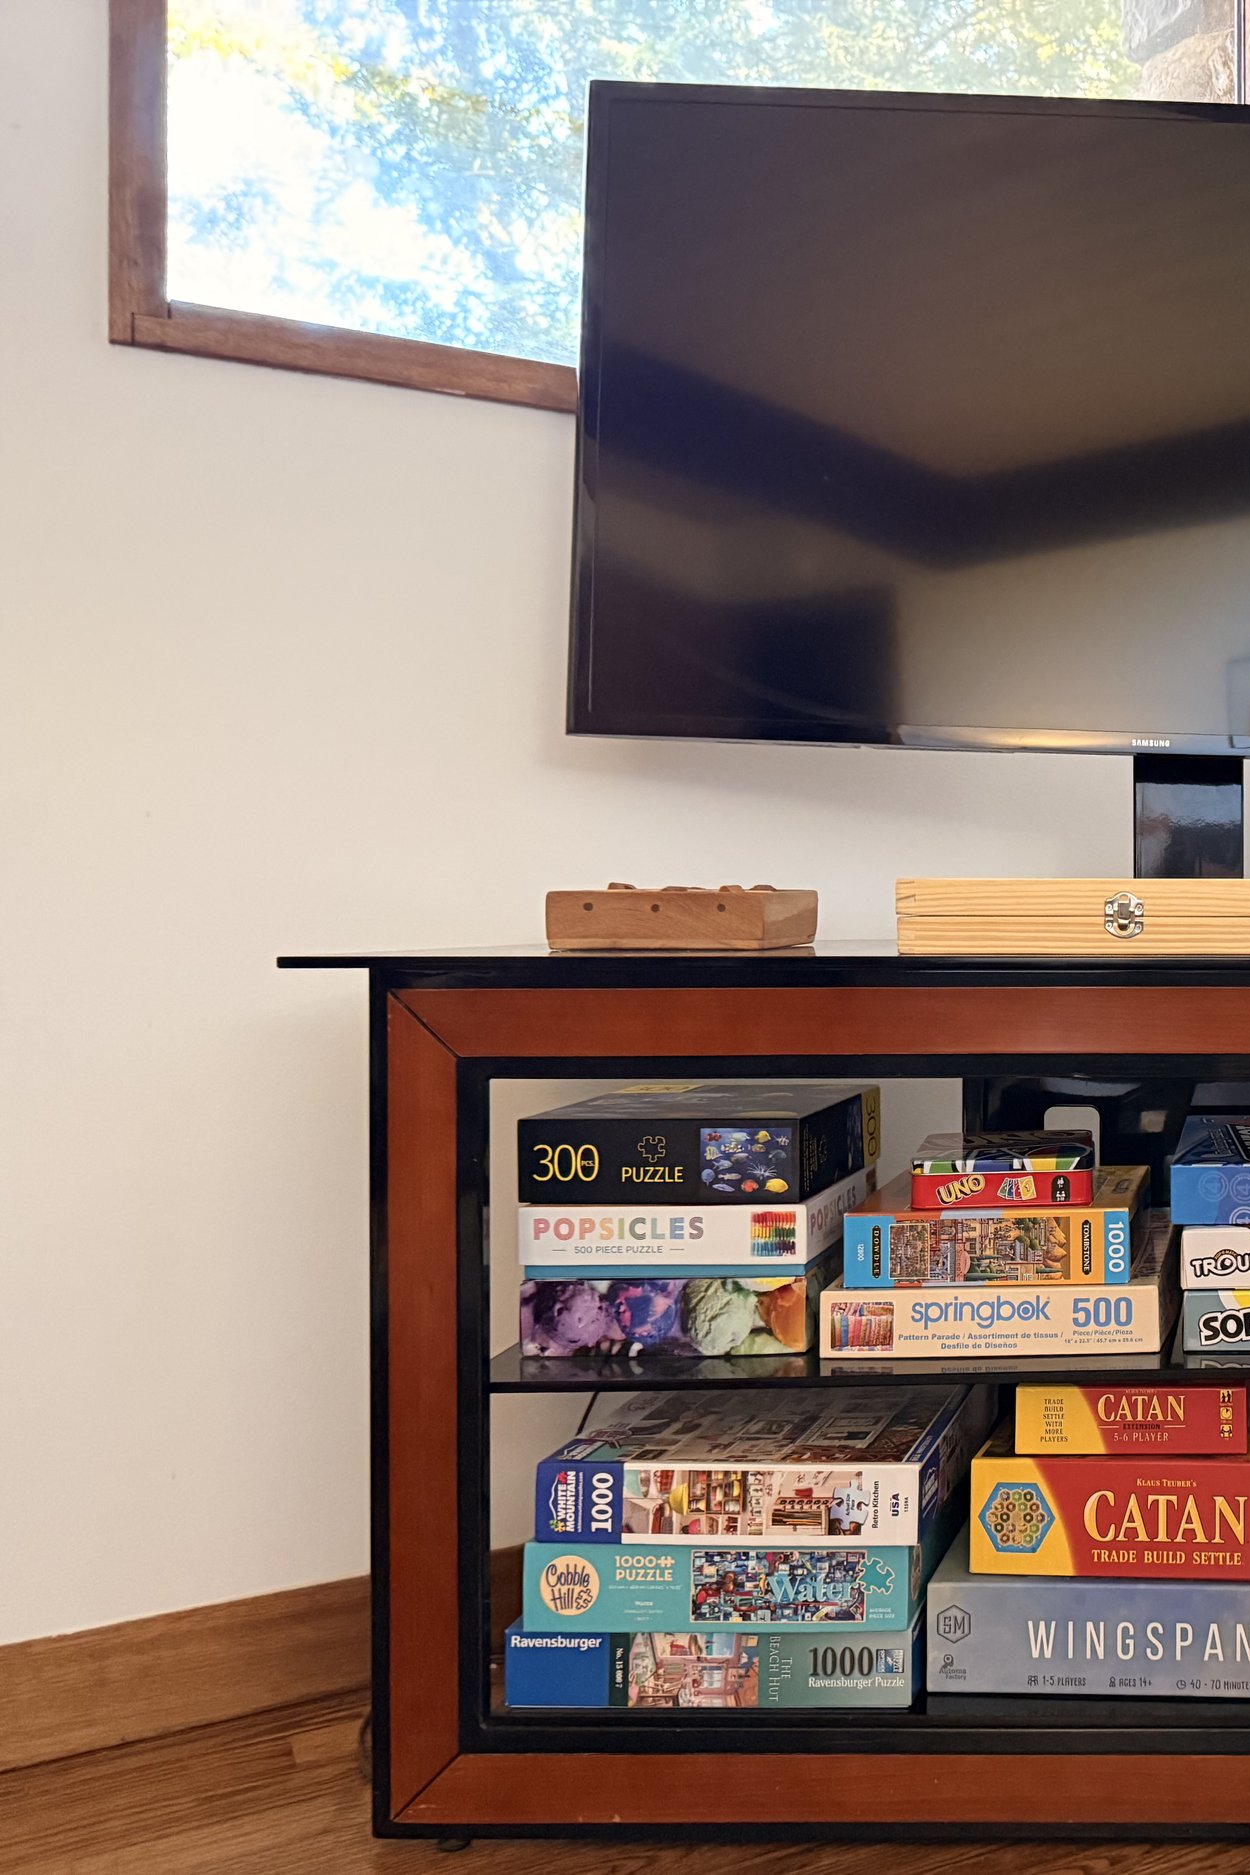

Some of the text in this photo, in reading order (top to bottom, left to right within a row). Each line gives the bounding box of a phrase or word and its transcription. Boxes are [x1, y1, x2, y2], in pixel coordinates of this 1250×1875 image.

[1131, 738, 1170, 747] SAMSUNG
[865, 1098, 878, 1157] 300
[532, 1144, 599, 1182] 300
[621, 1166, 684, 1183] PUZZLE
[936, 1174, 986, 1205] UNO
[810, 1185, 857, 1236] POPSICLES
[532, 1216, 704, 1242] POPSICLES
[574, 1245, 663, 1254] 500 PIECE PUZZLE
[1108, 1221, 1125, 1272] 1000
[910, 1295, 1051, 1330] springbok
[1072, 1296, 1133, 1328] 500
[898, 1333, 929, 1341] Pattern
[931, 1333, 961, 1341] Parade
[967, 1332, 1019, 1340] Assortiment
[1034, 1331, 1059, 1339] tissus
[941, 1342, 969, 1350] Desfile
[984, 1341, 1018, 1349] Diseños
[1097, 1394, 1186, 1422] CATAN
[1113, 1432, 1169, 1442] 5-6 PLAYER
[1137, 1478, 1160, 1487] KLAUS
[557, 1471, 576, 1532] WHITE MOUNTAIN
[591, 1472, 614, 1533] 1000
[891, 1493, 900, 1517] USA
[1083, 1490, 1248, 1545] CATAN
[614, 1555, 657, 1568] 1000
[1092, 1550, 1242, 1566] TRADE BUILD SETTLE
[546, 1563, 590, 1588] Cobble
[615, 1569, 673, 1581] PUZZLE
[768, 1572, 859, 1602] Water
[551, 1588, 575, 1612] Hill
[943, 1616, 965, 1634] SM
[511, 1635, 602, 1651] Ravensburger
[768, 1636, 781, 1701] BEACH HUT
[780, 1657, 793, 1679] THE
[808, 1646, 873, 1677] 1000
[939, 1667, 967, 1675] Automa
[808, 1676, 905, 1690] Ravensburger Puzzle
[1042, 1675, 1087, 1687] 1-5 PLAYERS
[1119, 1678, 1137, 1688] AGES
[1190, 1679, 1202, 1690] 40
[1211, 1679, 1221, 1690] 70
